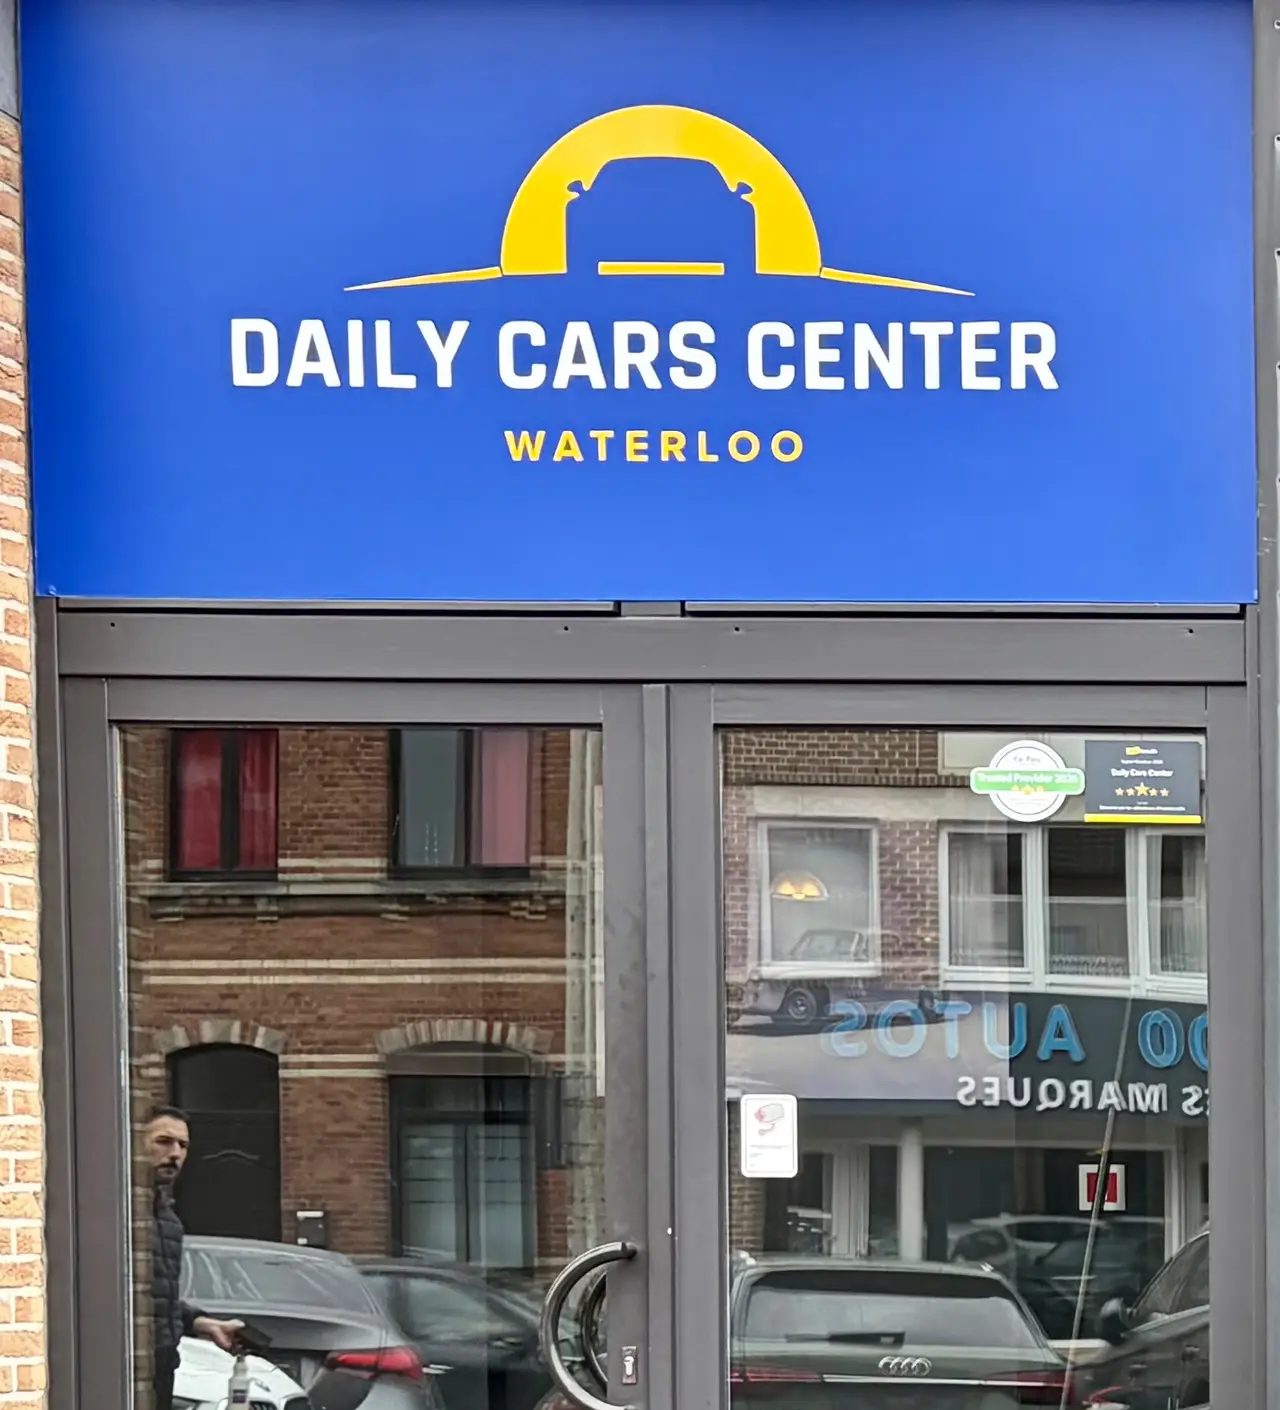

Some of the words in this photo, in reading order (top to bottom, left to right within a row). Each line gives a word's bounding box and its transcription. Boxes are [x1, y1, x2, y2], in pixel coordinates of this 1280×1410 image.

[230, 317, 470, 389] DAILY
[498, 319, 717, 390] CARS
[747, 320, 1059, 391] CENTER
[504, 429, 804, 463] WATERLOO
